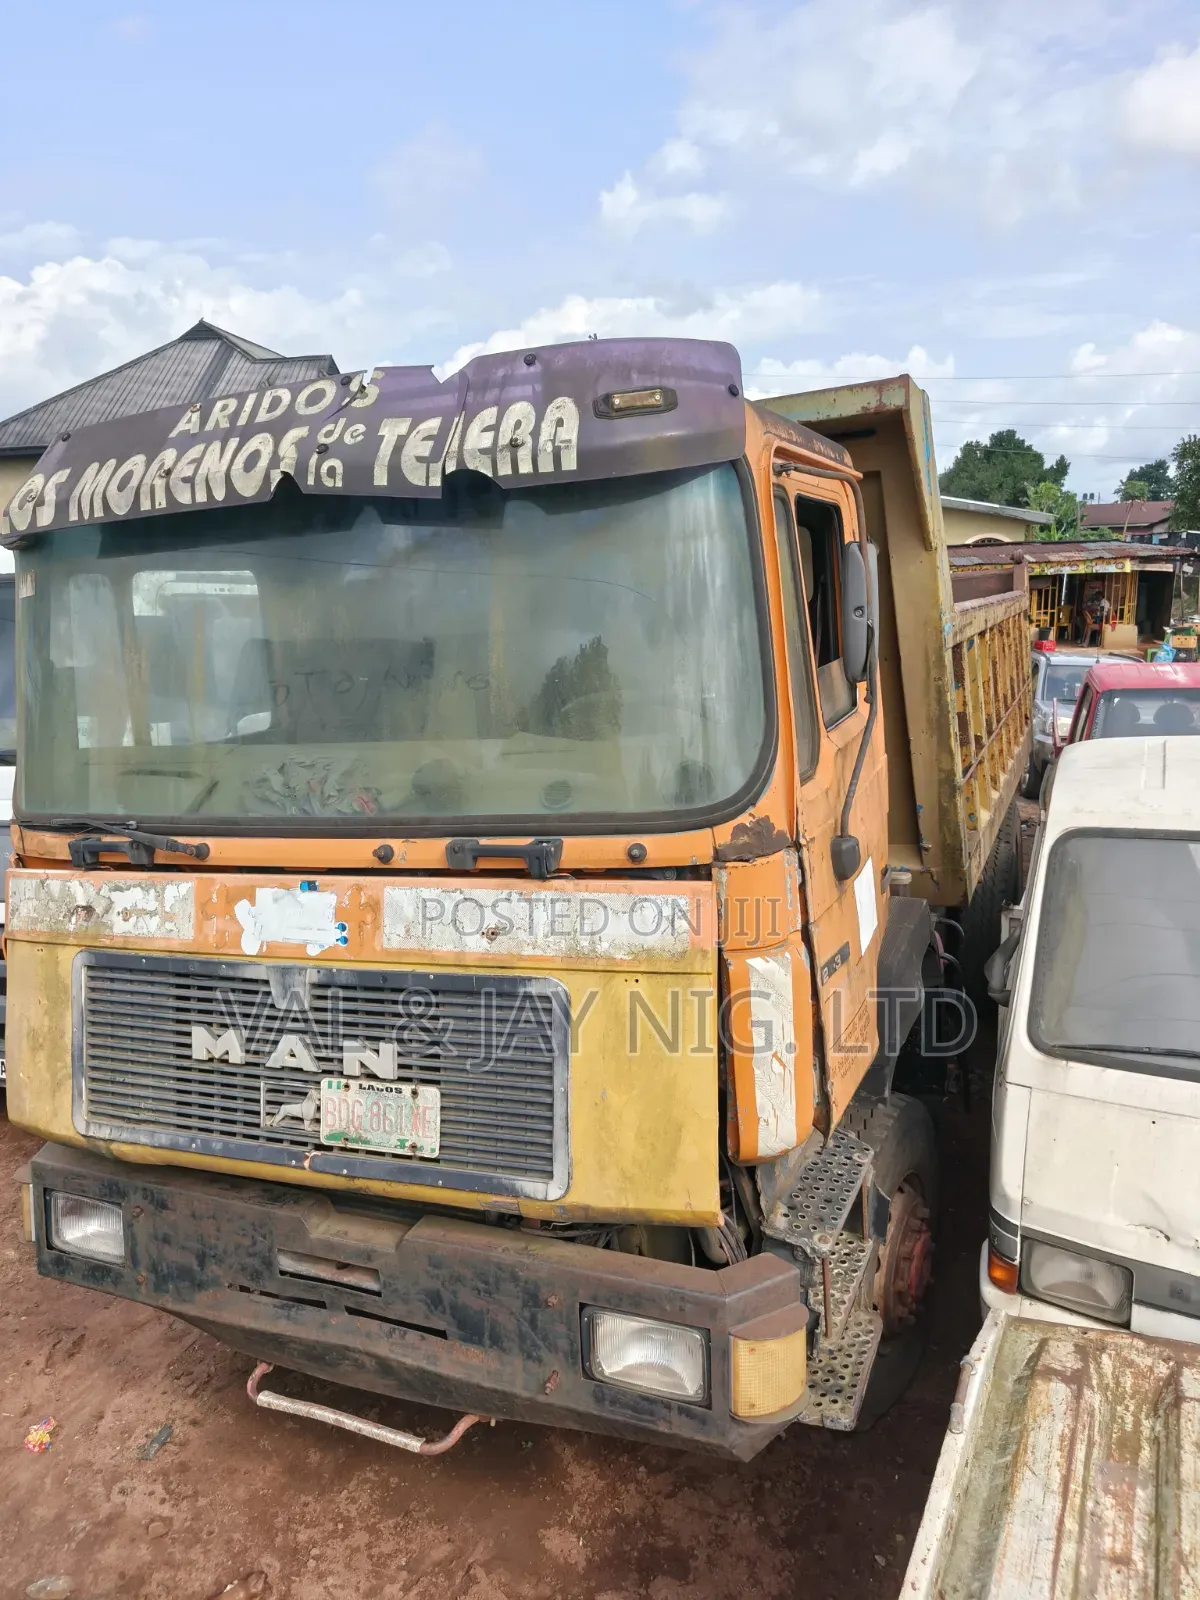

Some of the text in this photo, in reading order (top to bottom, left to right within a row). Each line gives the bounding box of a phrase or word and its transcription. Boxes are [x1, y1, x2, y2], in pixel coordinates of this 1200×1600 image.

[168, 370, 385, 438] ARIDOS
[69, 426, 310, 522] MORENOS
[317, 418, 367, 445] de
[373, 396, 580, 487] TEJERA
[191, 1026, 398, 1080] MAN
